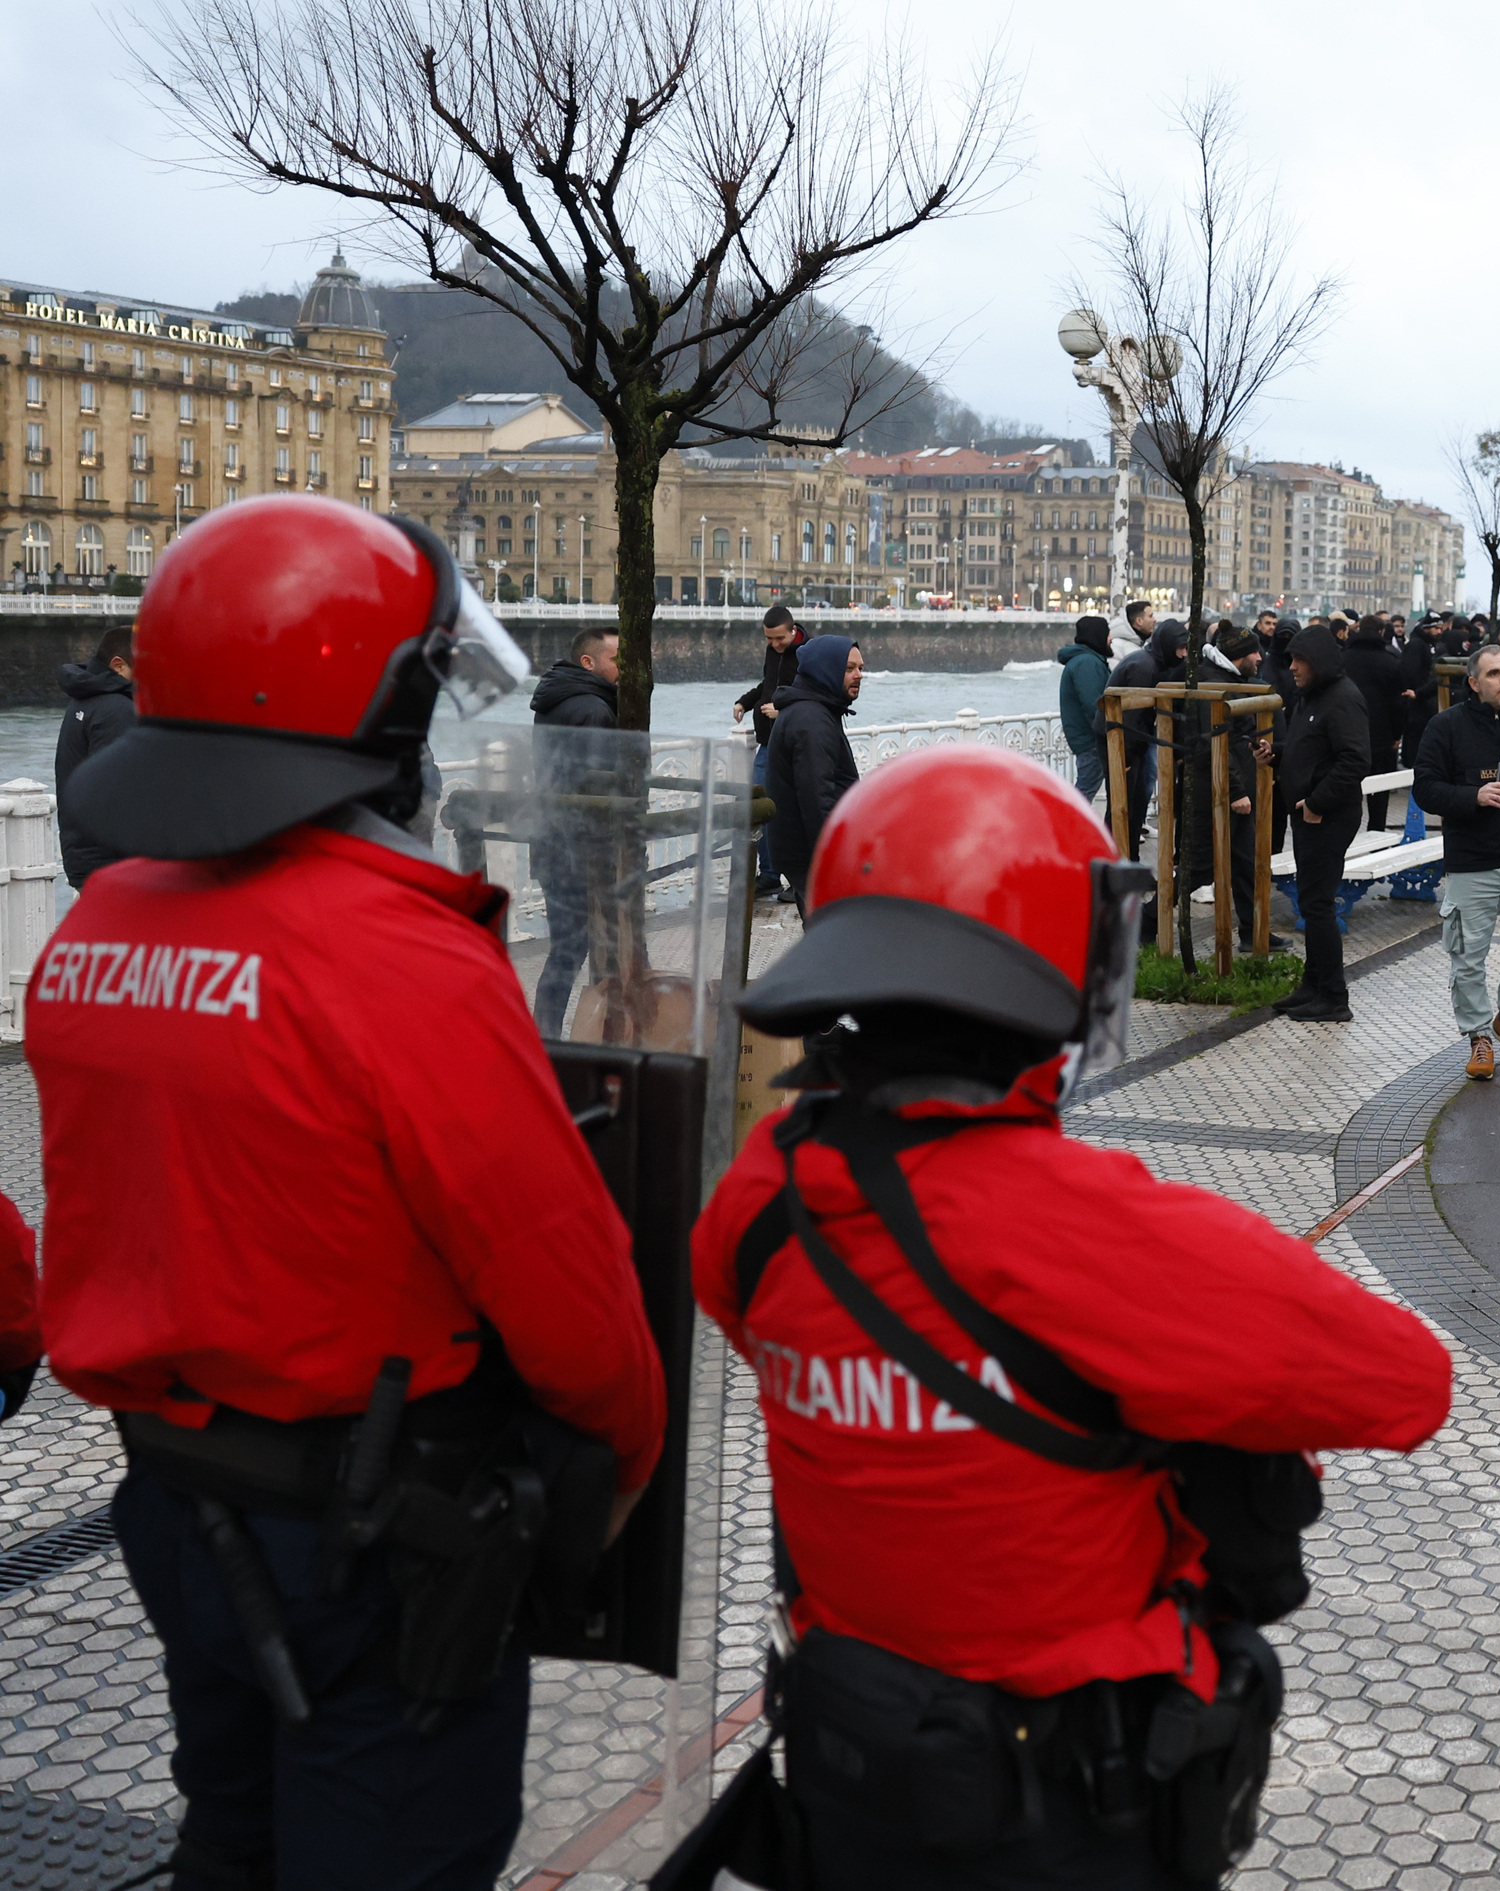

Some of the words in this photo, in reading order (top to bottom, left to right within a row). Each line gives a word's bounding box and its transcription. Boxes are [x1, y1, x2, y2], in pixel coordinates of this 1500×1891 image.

[26, 301, 88, 326] HOTEL
[100, 314, 157, 336] MARIA
[168, 325, 245, 349] CRISTINA
[36, 942, 262, 1021] ERTZAINTZA
